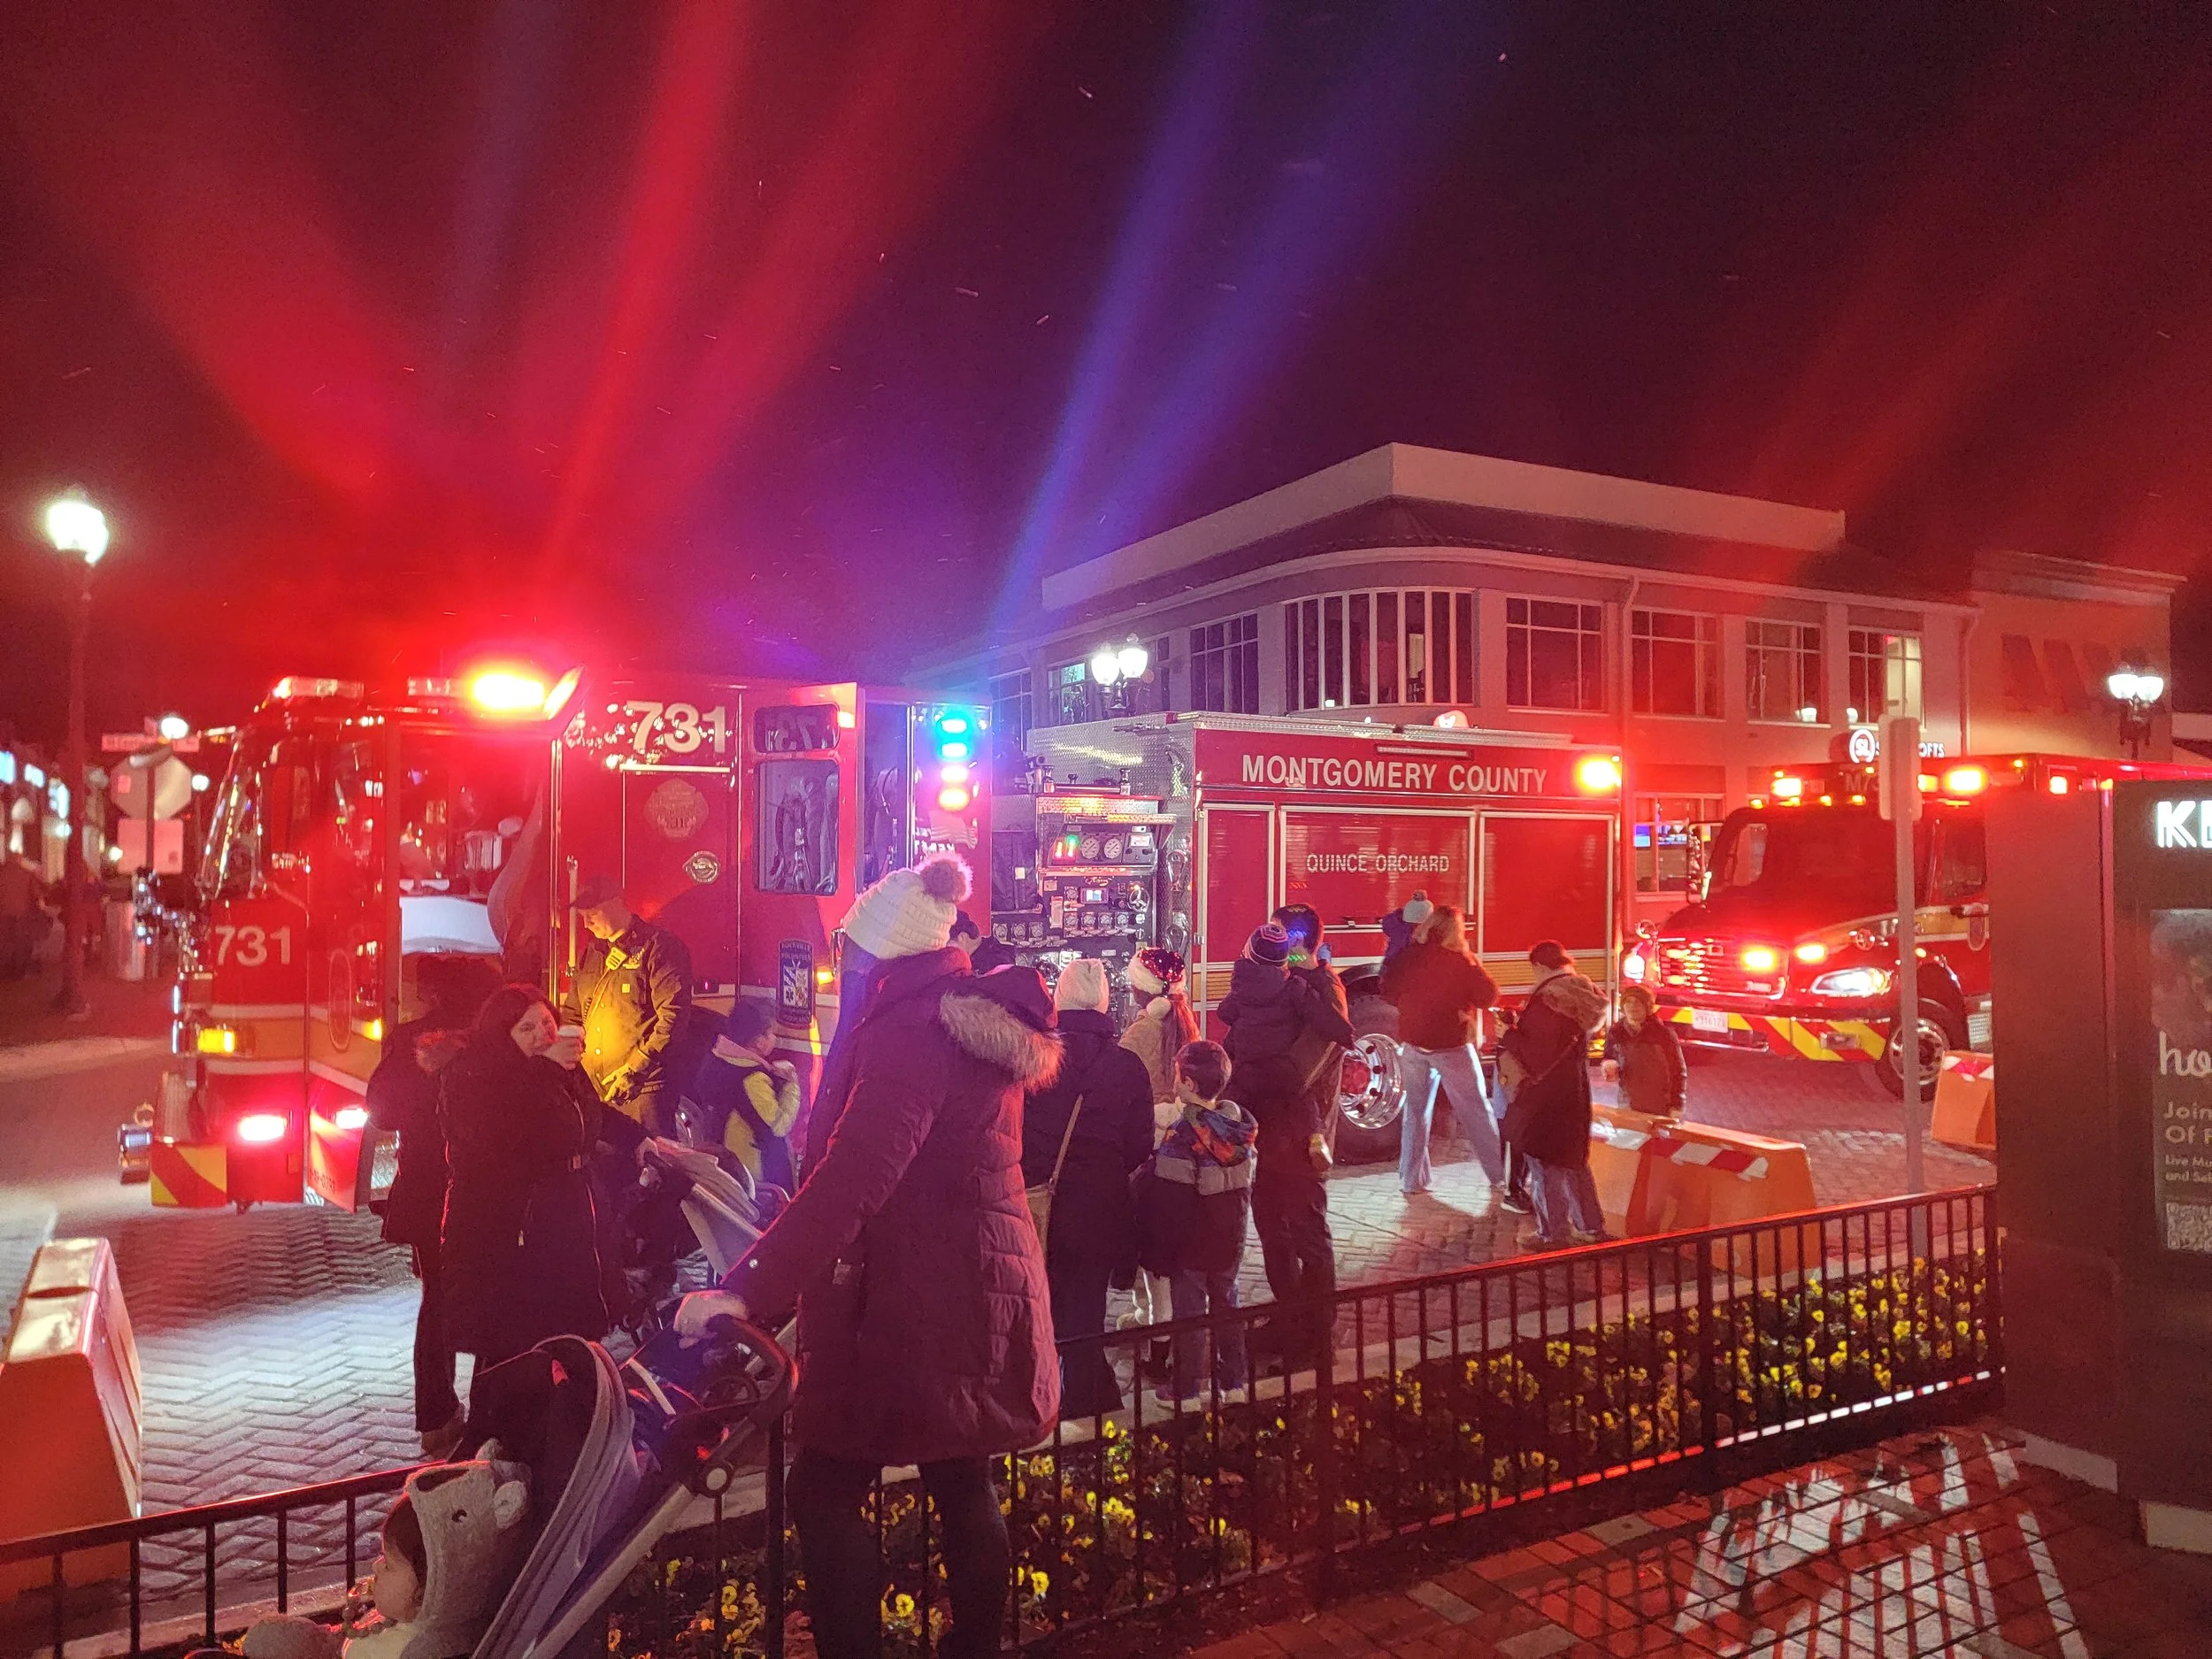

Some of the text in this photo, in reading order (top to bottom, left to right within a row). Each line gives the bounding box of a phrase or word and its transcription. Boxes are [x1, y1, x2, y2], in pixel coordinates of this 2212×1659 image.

[626, 700, 726, 753] 731
[1917, 741, 1945, 757] OFTS
[1242, 754, 1547, 793] MONTGOMERY COUNTY
[1306, 853, 1450, 872] QUINCE ORCHARD
[215, 925, 291, 967] 731
[2165, 1125, 2195, 1144] Of
